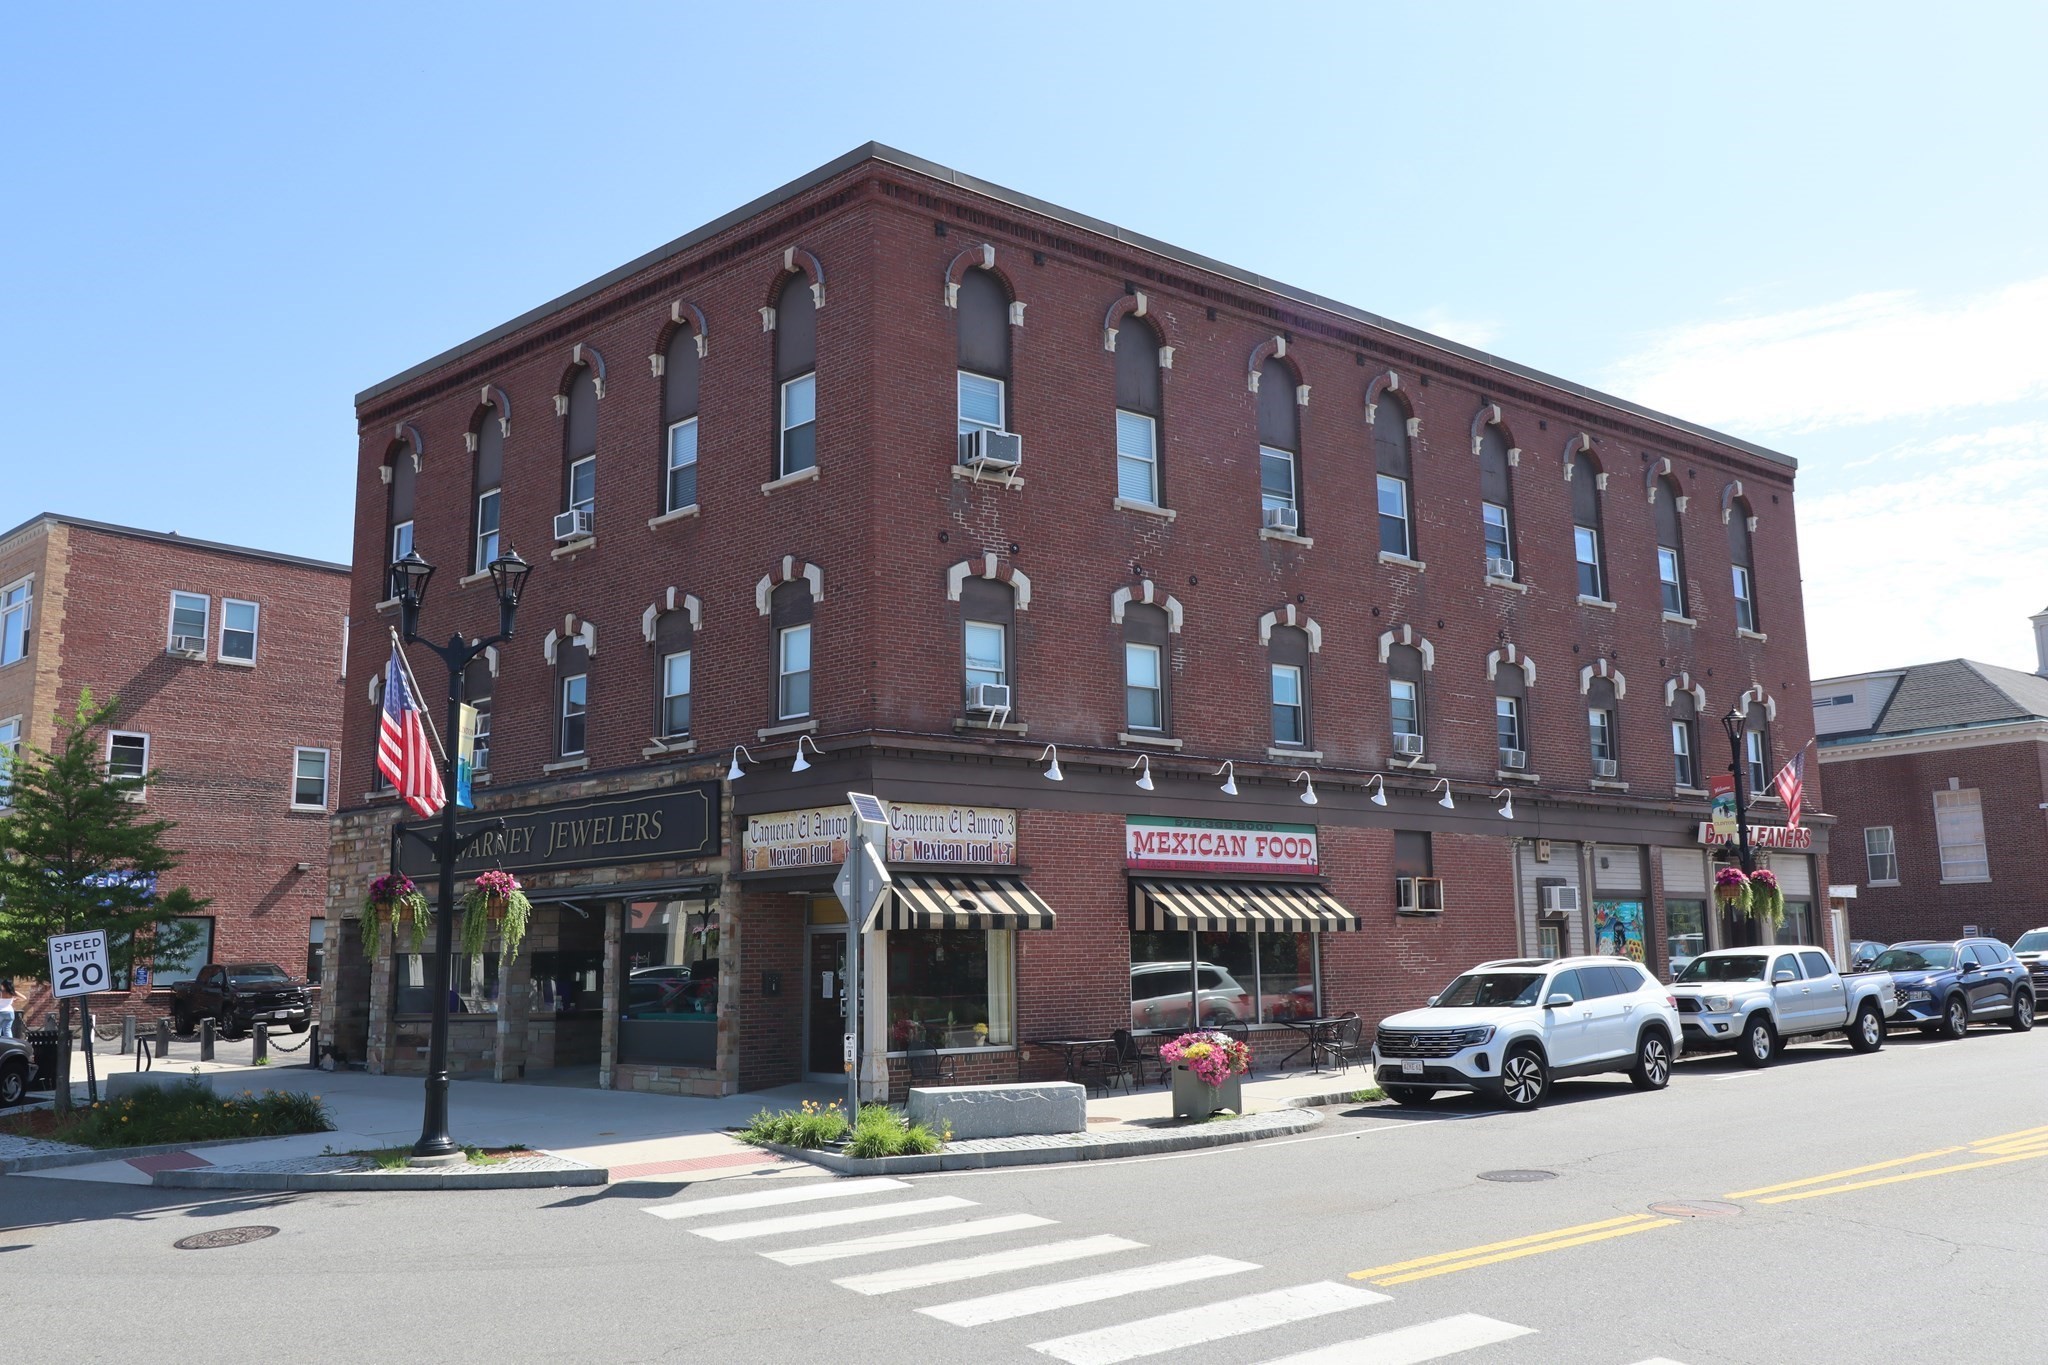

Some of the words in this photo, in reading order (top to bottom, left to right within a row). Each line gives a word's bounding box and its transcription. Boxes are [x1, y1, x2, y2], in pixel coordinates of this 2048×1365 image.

[543, 809, 664, 858] JEWELERS
[750, 819, 794, 846] Taqueria
[797, 814, 810, 839] El
[813, 811, 848, 840] Amigo
[891, 806, 945, 836] Taqueria
[948, 809, 963, 834] El
[967, 809, 1004, 839] Amigo
[1007, 813, 1015, 836] 3
[1132, 830, 1247, 857] MEXICAN
[1255, 836, 1312, 859] FOOD
[1748, 826, 1812, 849] LEANERS
[769, 846, 807, 867] Mexican
[810, 842, 832, 864] Food
[913, 840, 963, 861] Mexican
[966, 842, 993, 862] Food
[54, 938, 101, 953] SPEED
[60, 950, 97, 965] LIMIT
[58, 962, 103, 990] 20
